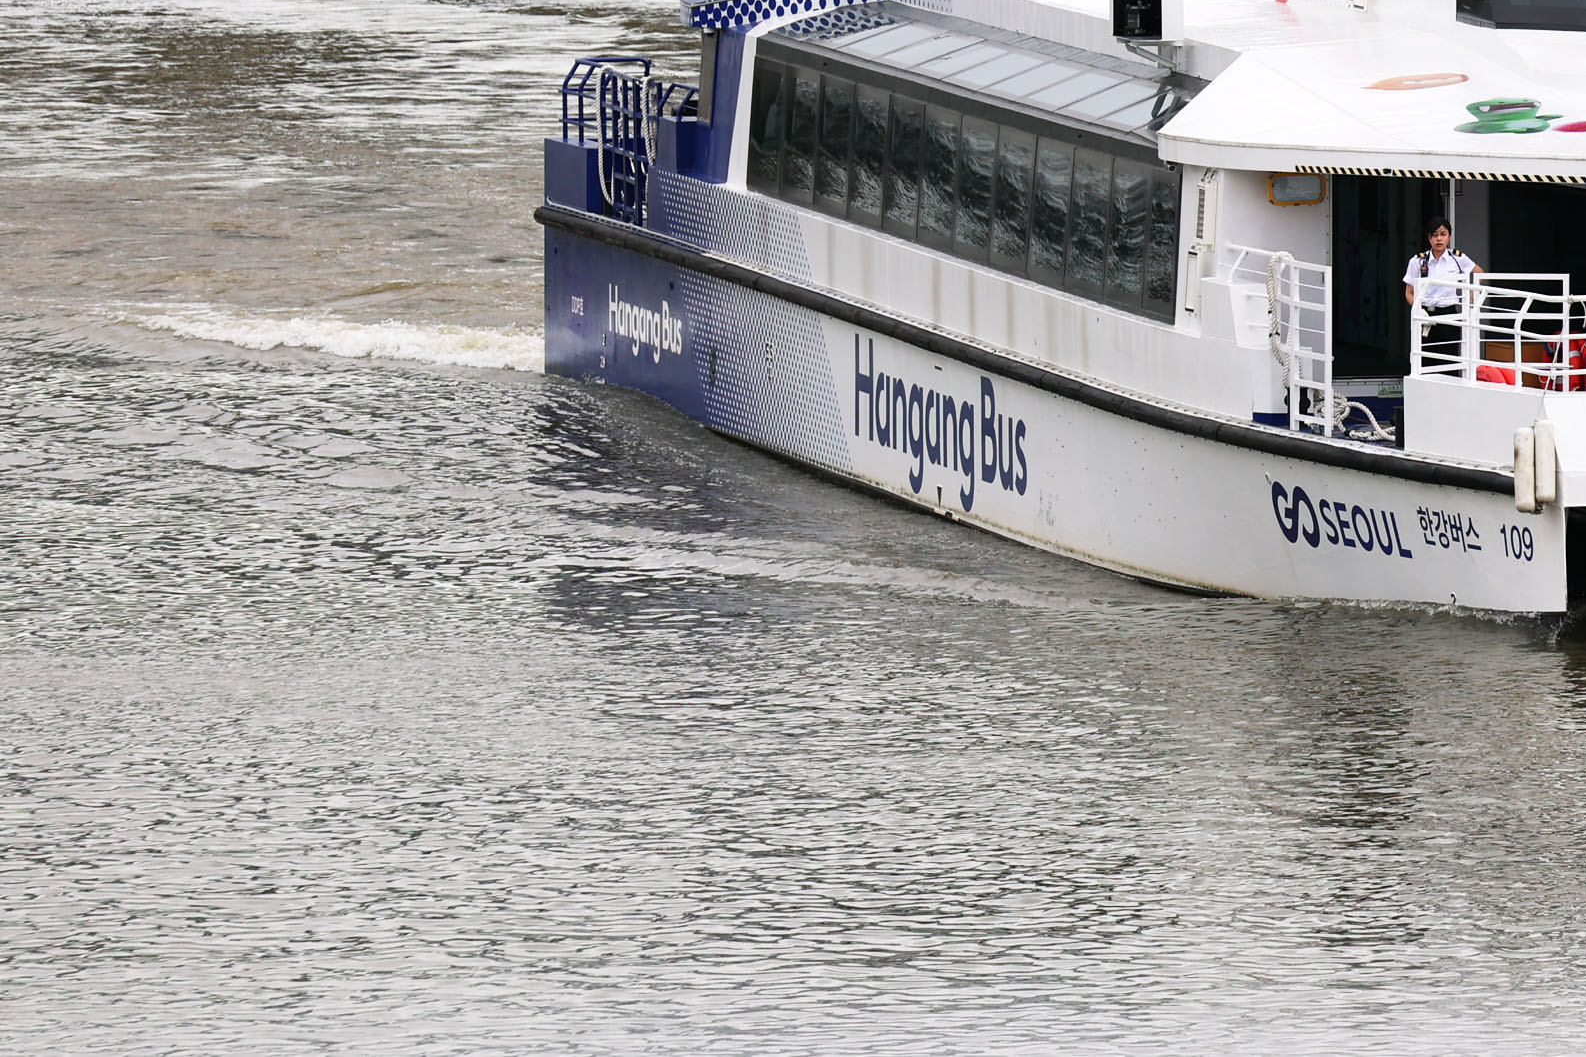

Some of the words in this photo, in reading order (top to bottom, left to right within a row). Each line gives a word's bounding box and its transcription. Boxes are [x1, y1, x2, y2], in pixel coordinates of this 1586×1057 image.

[608, 283, 660, 364] Hangang
[662, 300, 682, 355] Bus
[855, 333, 974, 512] Hangang
[981, 376, 1027, 496] Bus
[1416, 505, 1482, 553] 한강버스
[1500, 523, 1534, 562] 109
